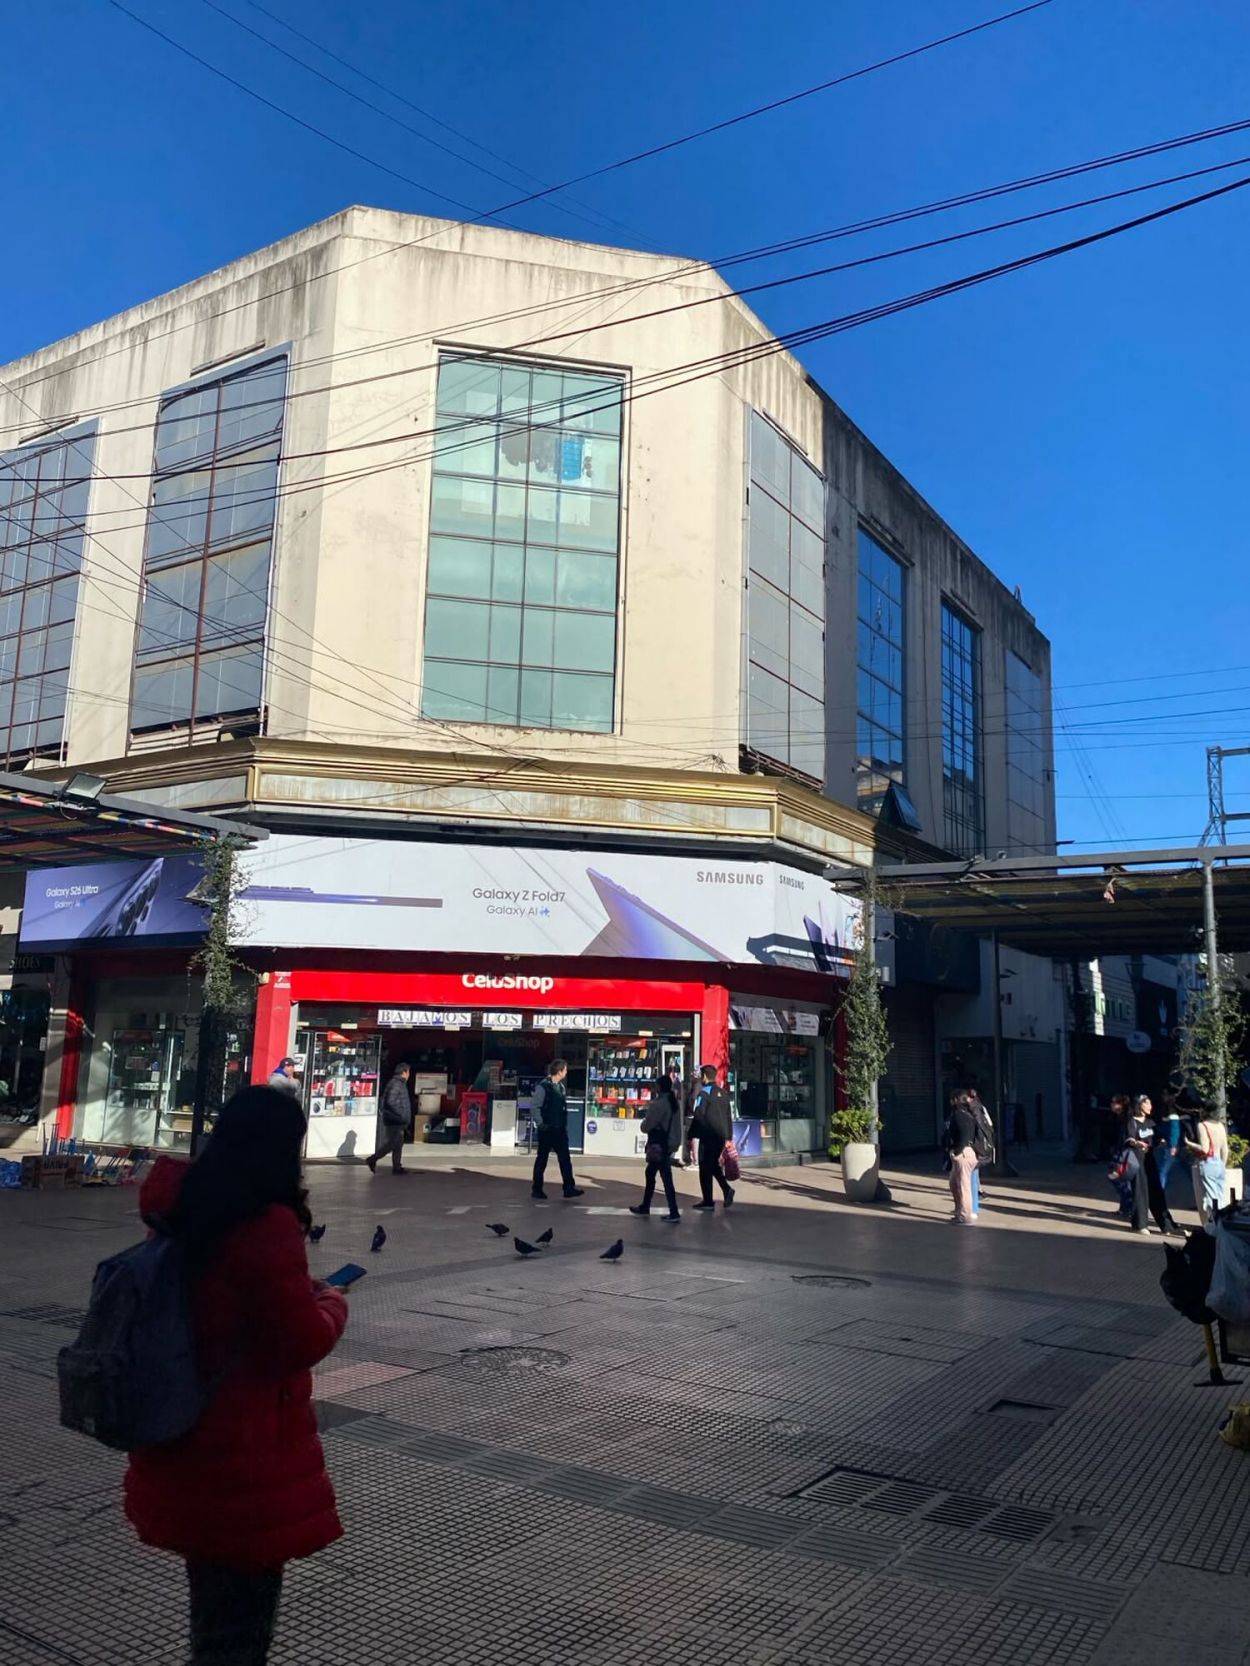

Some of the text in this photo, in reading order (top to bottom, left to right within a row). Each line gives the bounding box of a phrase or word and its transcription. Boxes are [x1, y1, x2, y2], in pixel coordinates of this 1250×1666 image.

[696, 871, 764, 885] SAMSUNG
[779, 874, 804, 890] SAMSUNG
[46, 888, 69, 898] Galaxy
[82, 884, 99, 894] Ultra
[472, 888, 566, 903] Galaxy Z Fold7
[486, 904, 538, 918] Galaxy AI
[461, 972, 554, 994] CeluShop
[380, 1010, 620, 1029] BAJAMOS LOS PRECIOS
